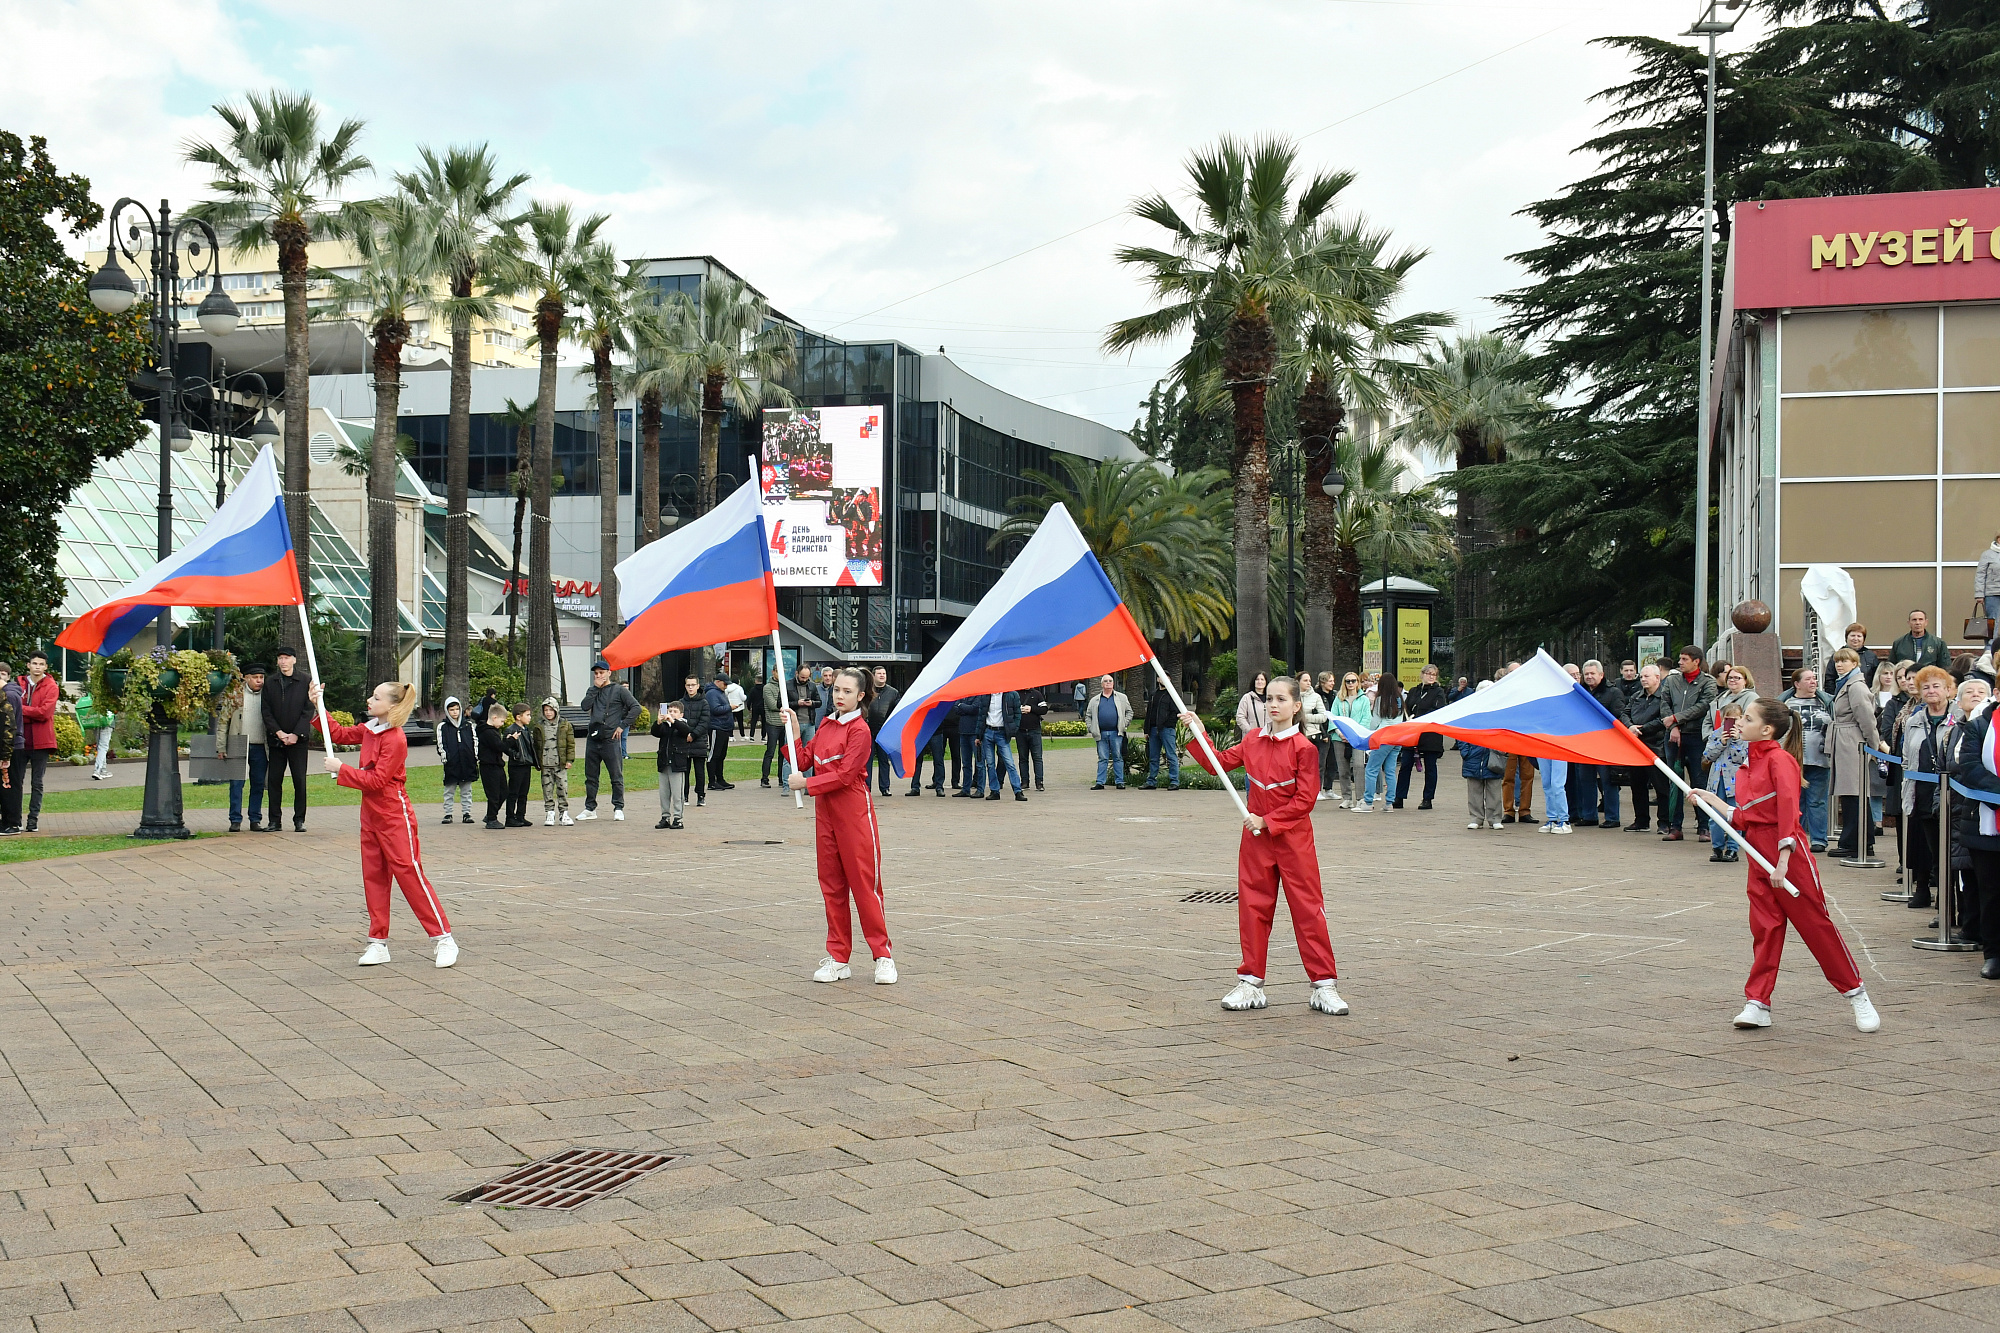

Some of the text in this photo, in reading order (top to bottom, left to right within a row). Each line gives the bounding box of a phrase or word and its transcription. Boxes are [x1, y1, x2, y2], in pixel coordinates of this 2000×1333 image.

[1811, 218, 1974, 270] МУЗЕЙ
[792, 526, 810, 534] ДЕНЬ
[792, 535, 832, 544] НАРОДНОГО
[792, 544, 828, 553] ЕДИНСТВА
[828, 596, 838, 640] МЕГА
[850, 596, 860, 651] МУЗЕЙ
[1402, 638, 1422, 646] Закажи
